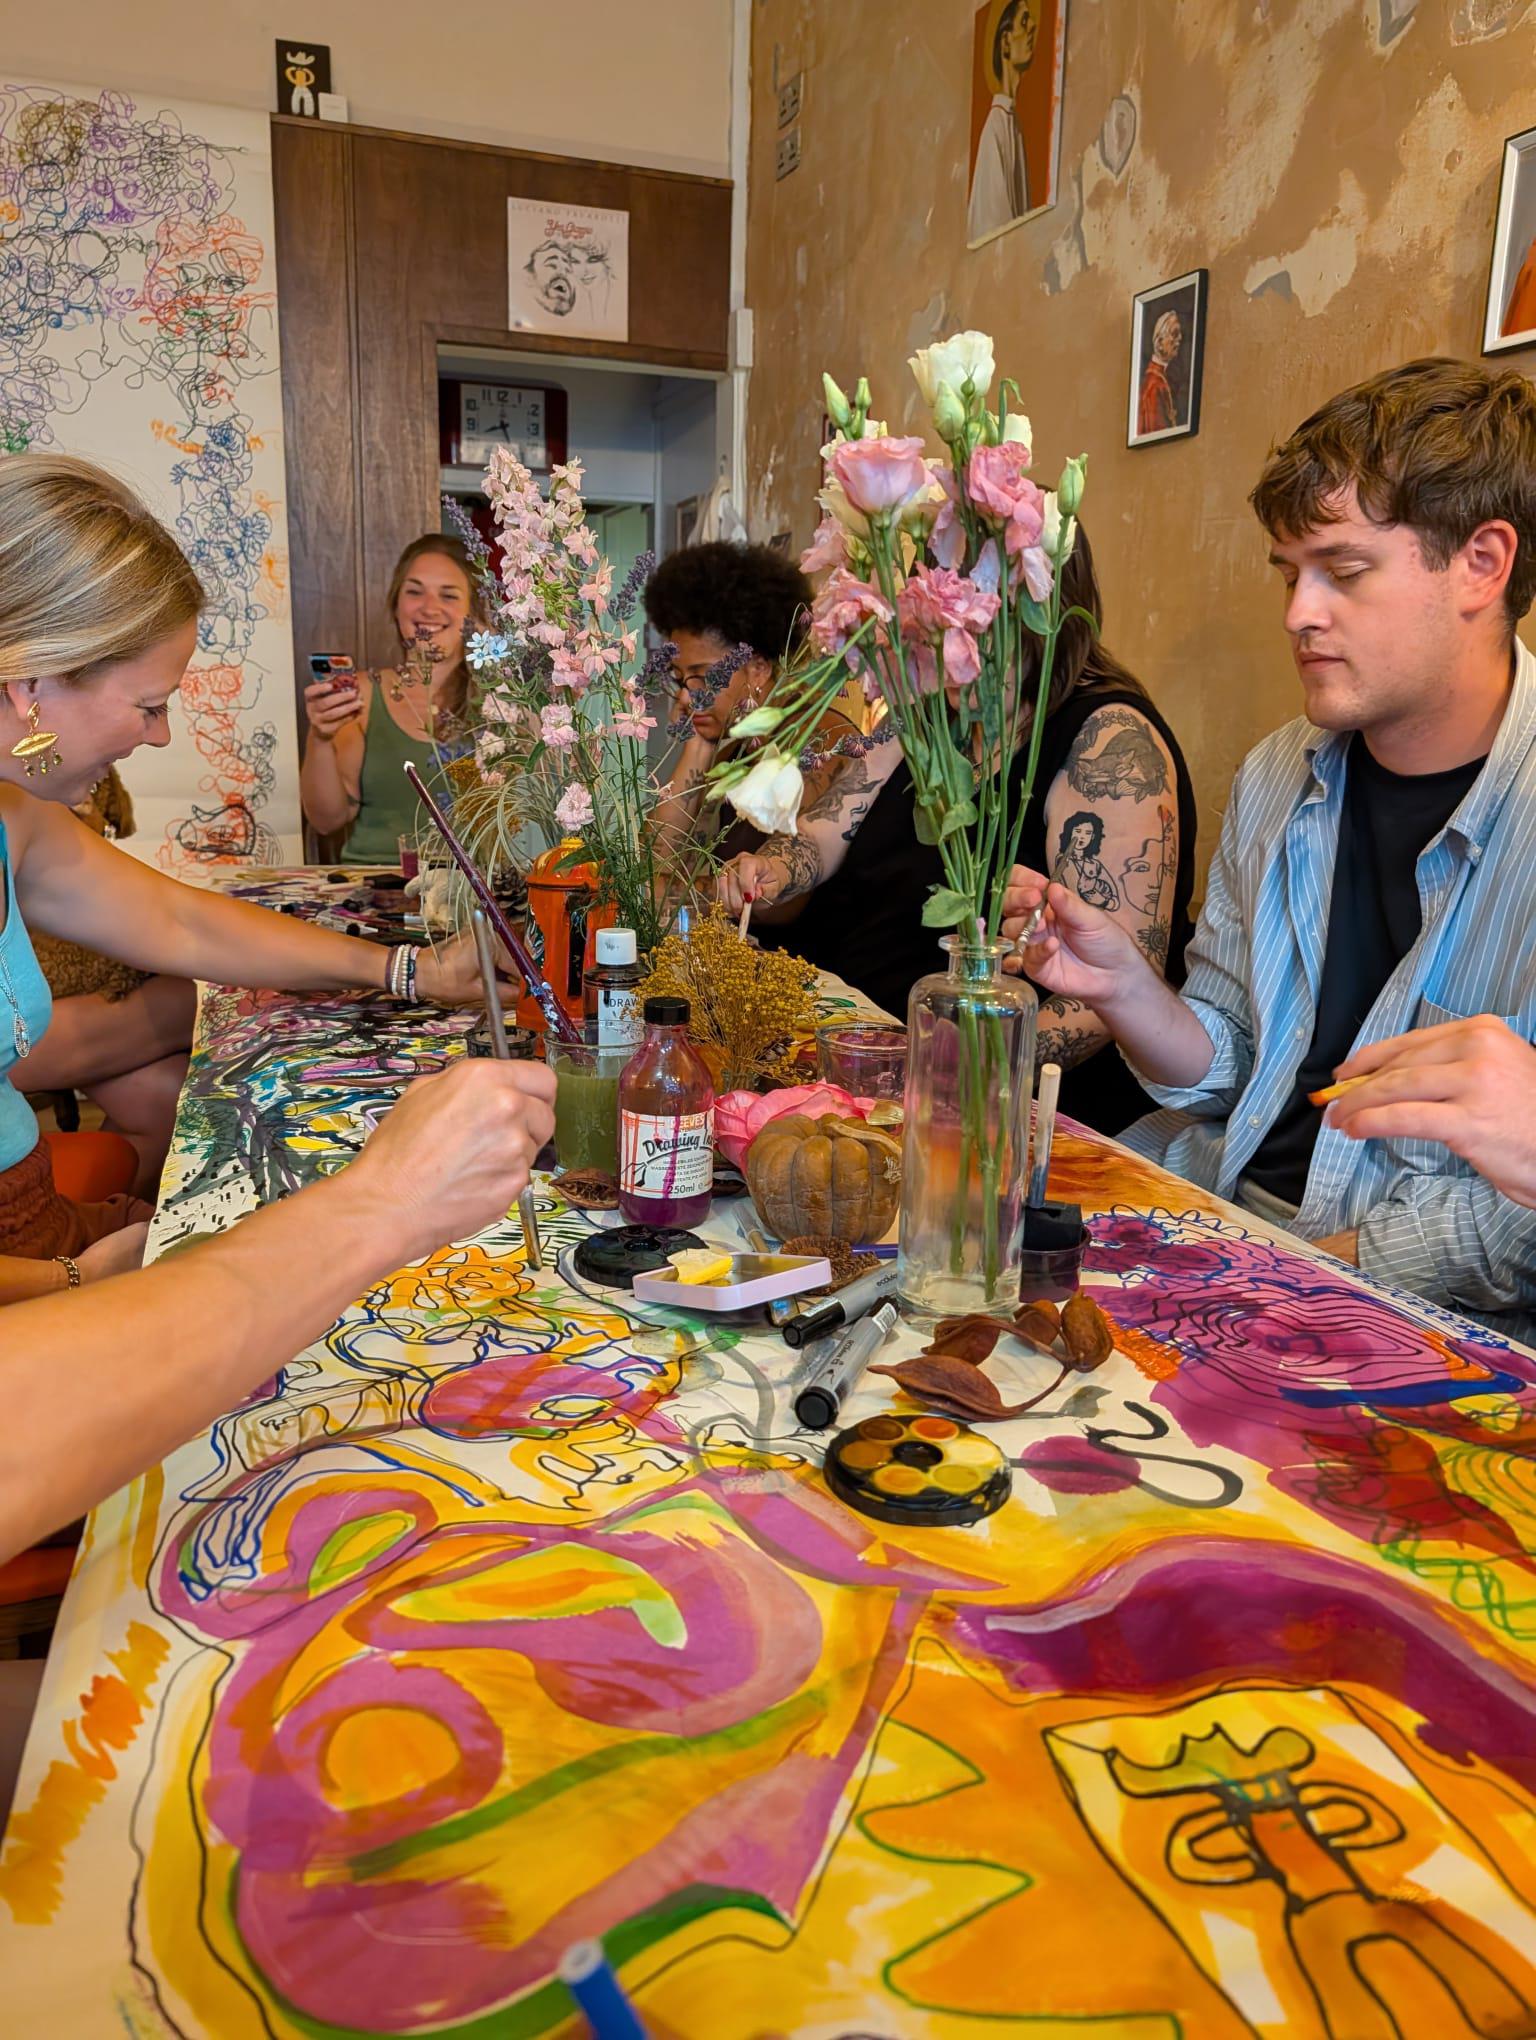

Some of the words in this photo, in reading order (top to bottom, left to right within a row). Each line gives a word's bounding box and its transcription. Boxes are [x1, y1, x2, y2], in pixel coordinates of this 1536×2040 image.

[482, 389, 491, 401] 11
[497, 390, 509, 403] 12
[531, 404, 539, 416] 2
[531, 423, 539, 436] 3
[642, 1133, 700, 1157] Drawing
[667, 1183, 695, 1194] 250ml
